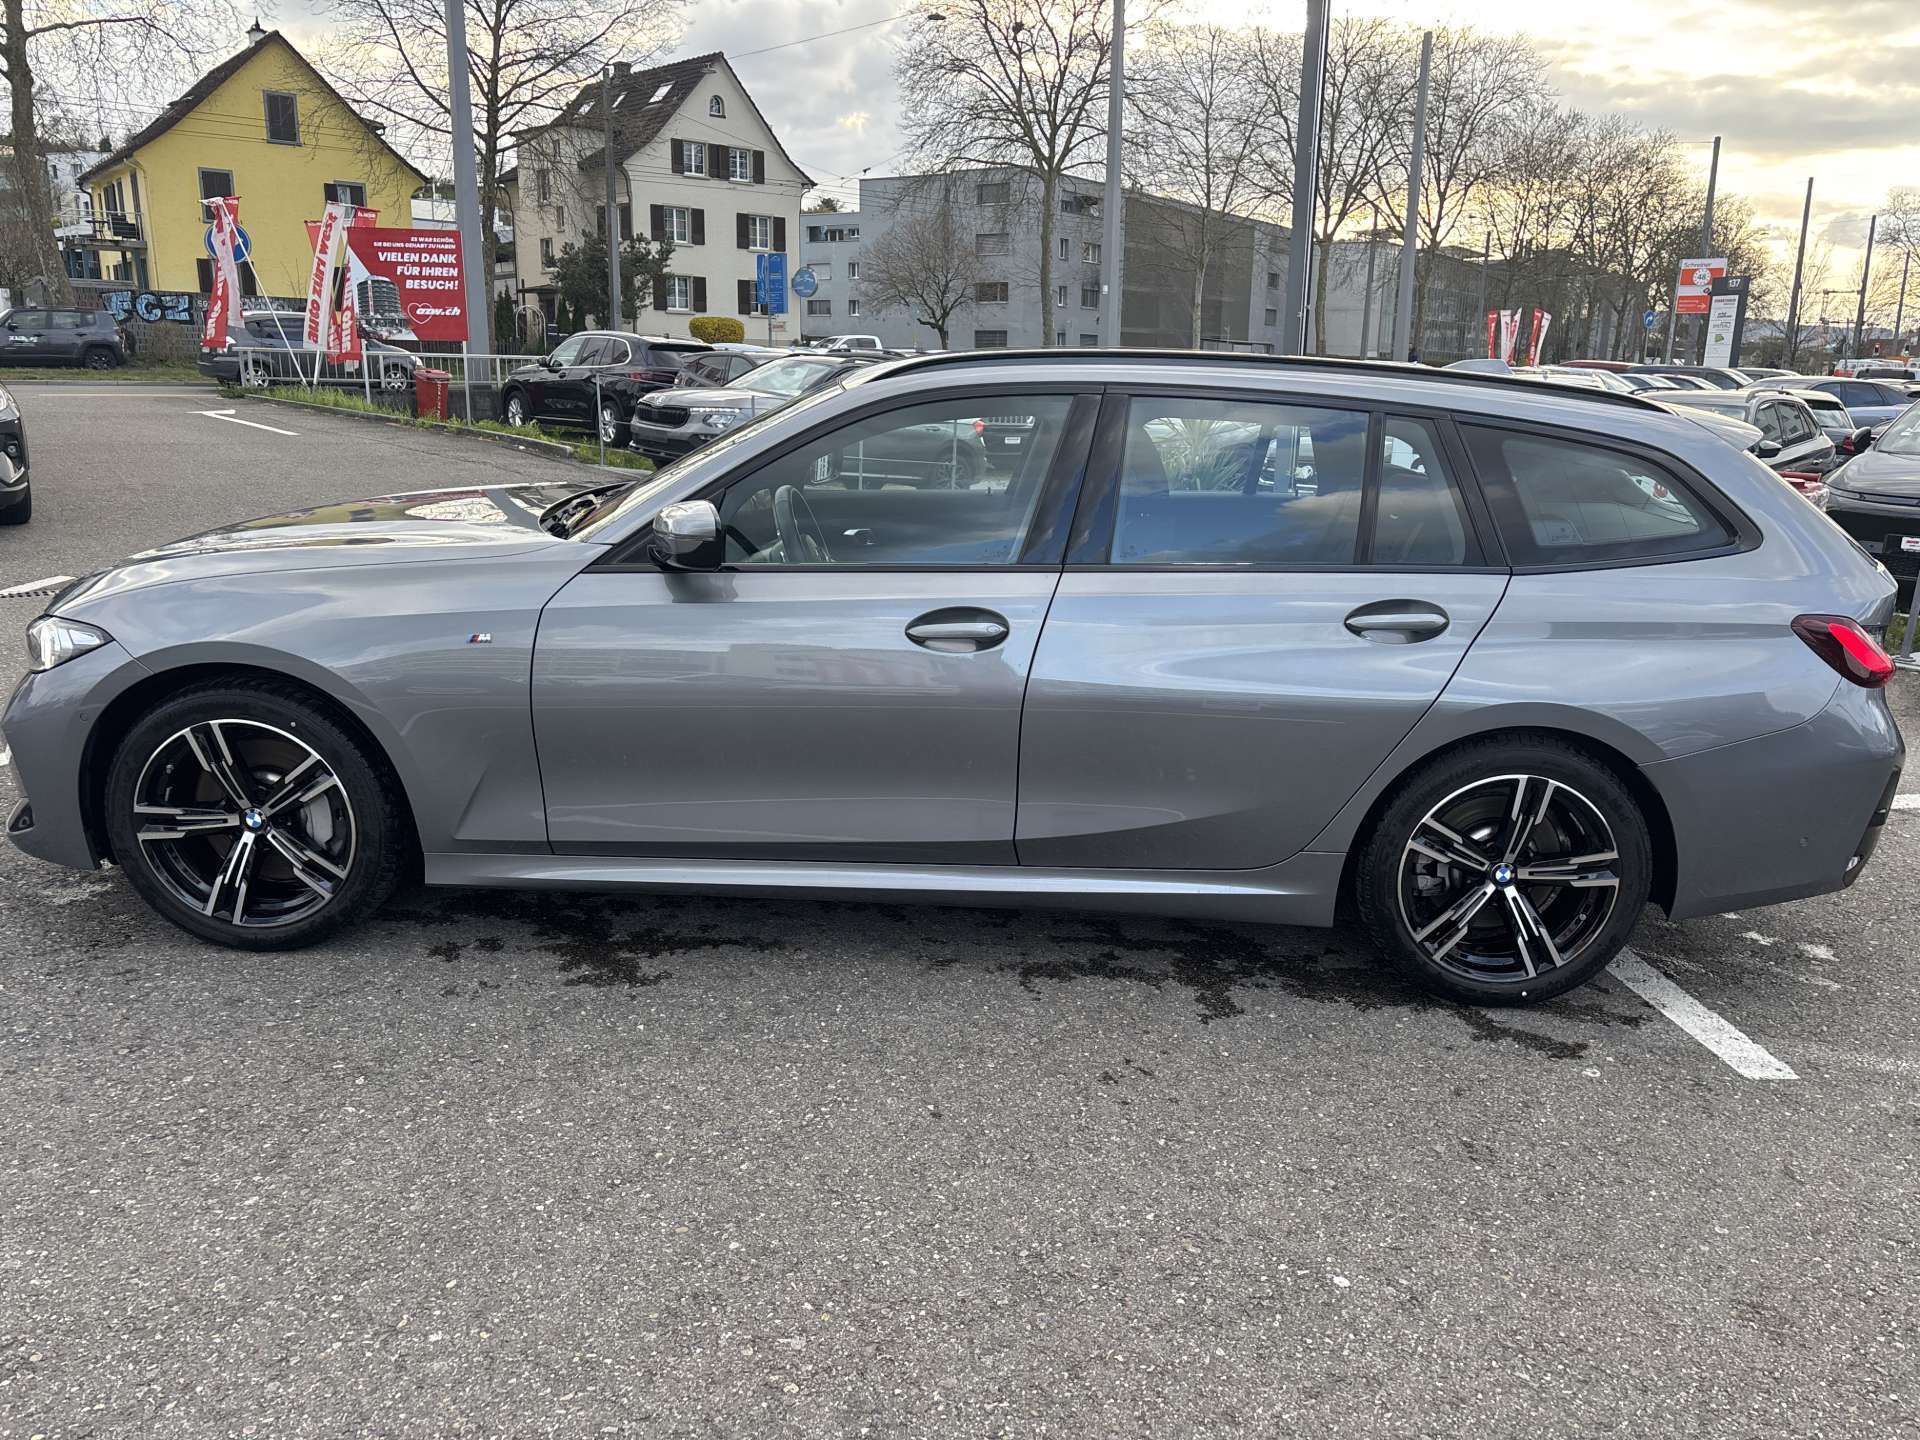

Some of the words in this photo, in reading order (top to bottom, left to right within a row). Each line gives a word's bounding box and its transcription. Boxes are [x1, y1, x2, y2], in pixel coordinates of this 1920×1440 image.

[378, 252, 419, 263] VIELEN
[421, 253, 457, 264] DANK
[396, 263, 420, 276] FÜR
[422, 266, 459, 277] IHREN
[307, 299, 320, 344] auto
[319, 212, 338, 255] west
[1728, 279, 1740, 287] 137
[405, 280, 458, 290] BESUCH!
